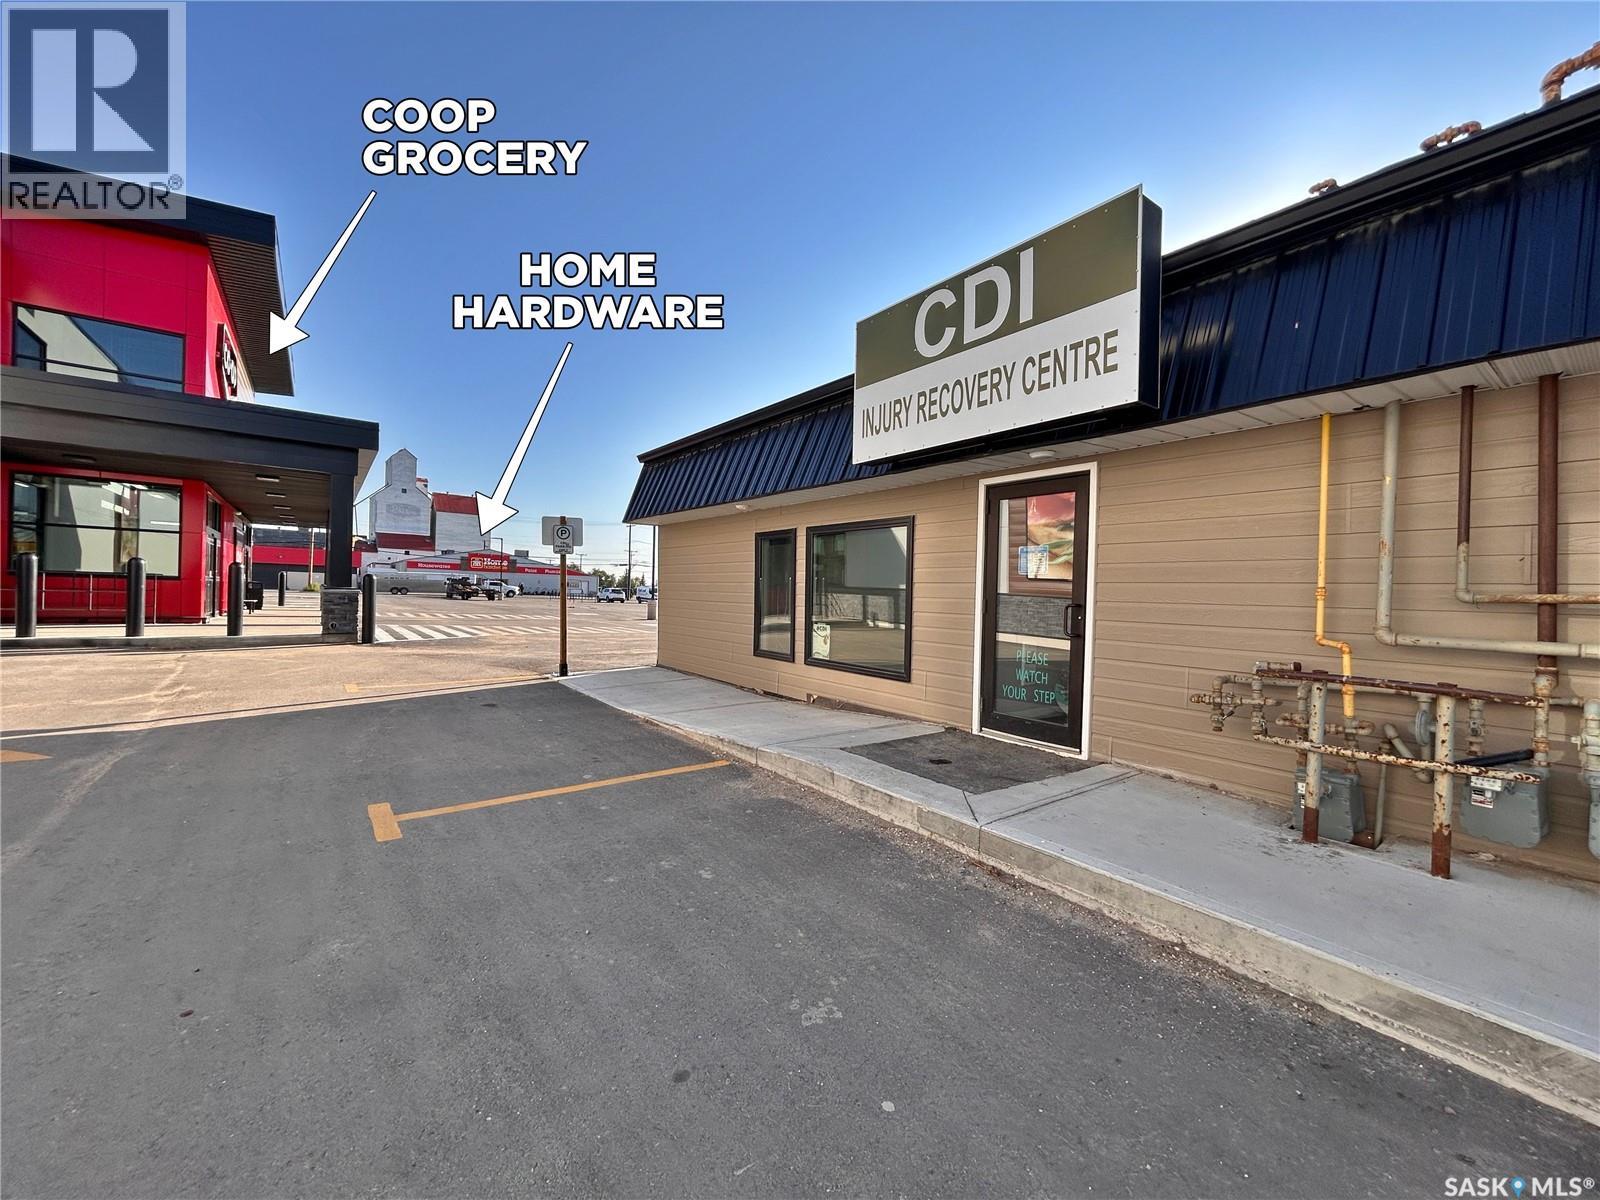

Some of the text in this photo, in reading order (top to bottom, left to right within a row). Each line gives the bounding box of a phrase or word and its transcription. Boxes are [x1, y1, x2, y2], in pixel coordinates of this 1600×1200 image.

[914, 246, 1035, 358] CDI
[861, 327, 1119, 440] INJURY RECOVERY CENTRE
[1016, 649, 1049, 666] PLEASE
[1015, 667, 1048, 685] WATCH
[1002, 684, 1056, 705] YOUR STEP
